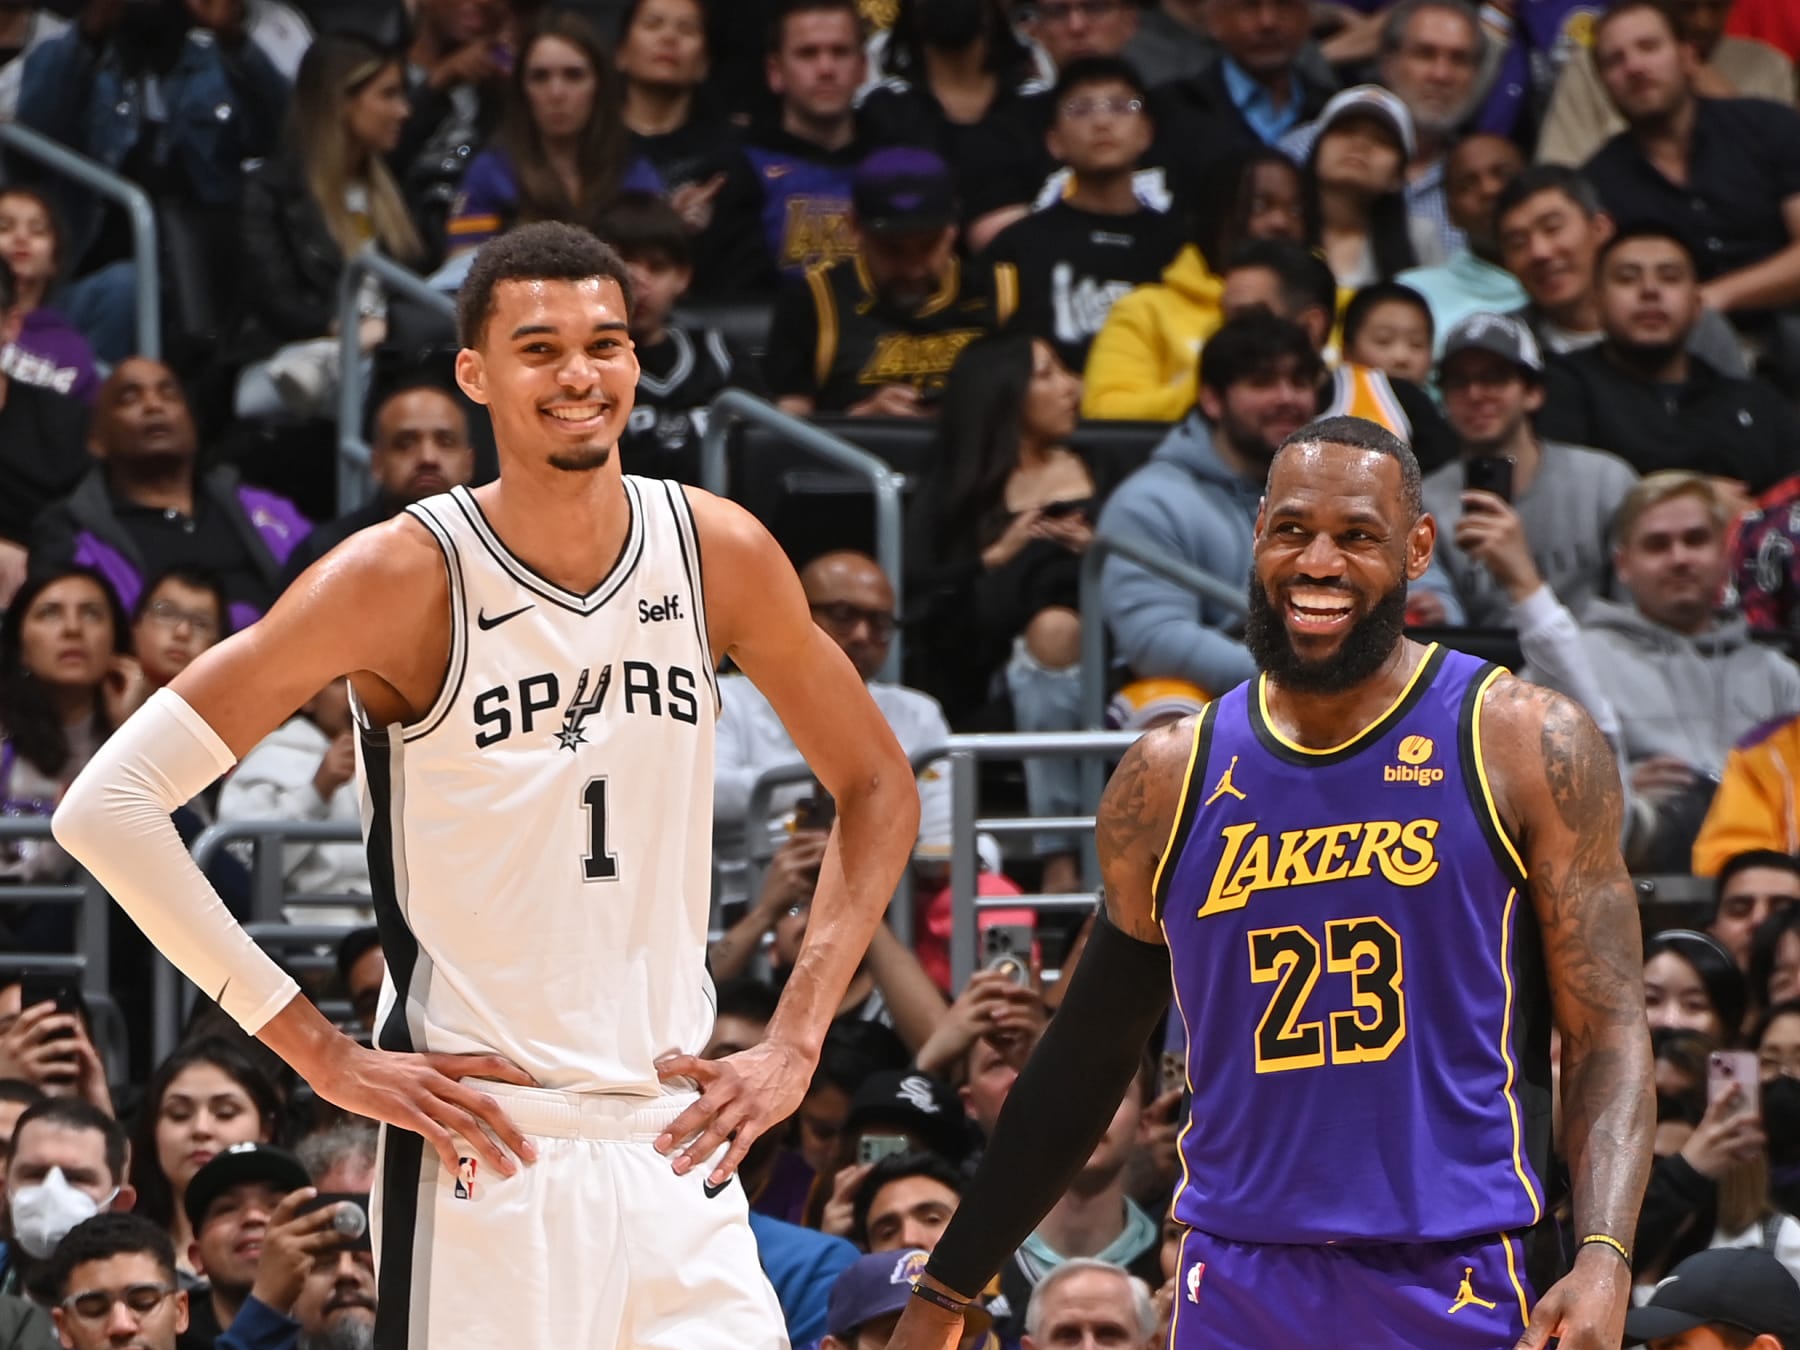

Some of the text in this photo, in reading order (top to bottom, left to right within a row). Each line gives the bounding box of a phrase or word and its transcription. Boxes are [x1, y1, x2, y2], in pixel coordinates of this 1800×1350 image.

[638, 594, 684, 624] Self.
[474, 661, 698, 753] SPURS
[1384, 765, 1445, 787] bibigo
[579, 774, 619, 883] 1
[1197, 818, 1441, 918] LAKERS
[1247, 916, 1406, 1074] 23
